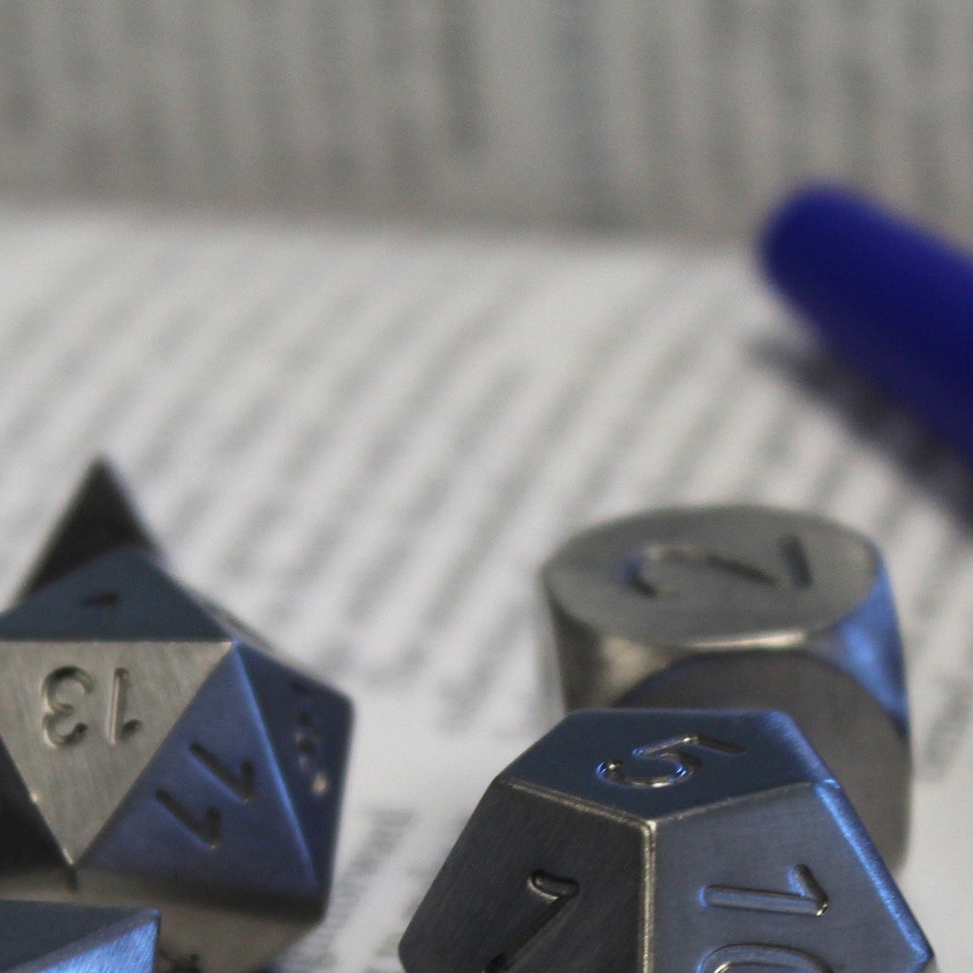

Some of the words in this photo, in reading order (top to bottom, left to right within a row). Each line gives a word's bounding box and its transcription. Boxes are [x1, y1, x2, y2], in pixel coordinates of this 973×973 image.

[39, 664, 143, 750] 13
[154, 740, 256, 851] 11
[595, 732, 747, 790] 5
